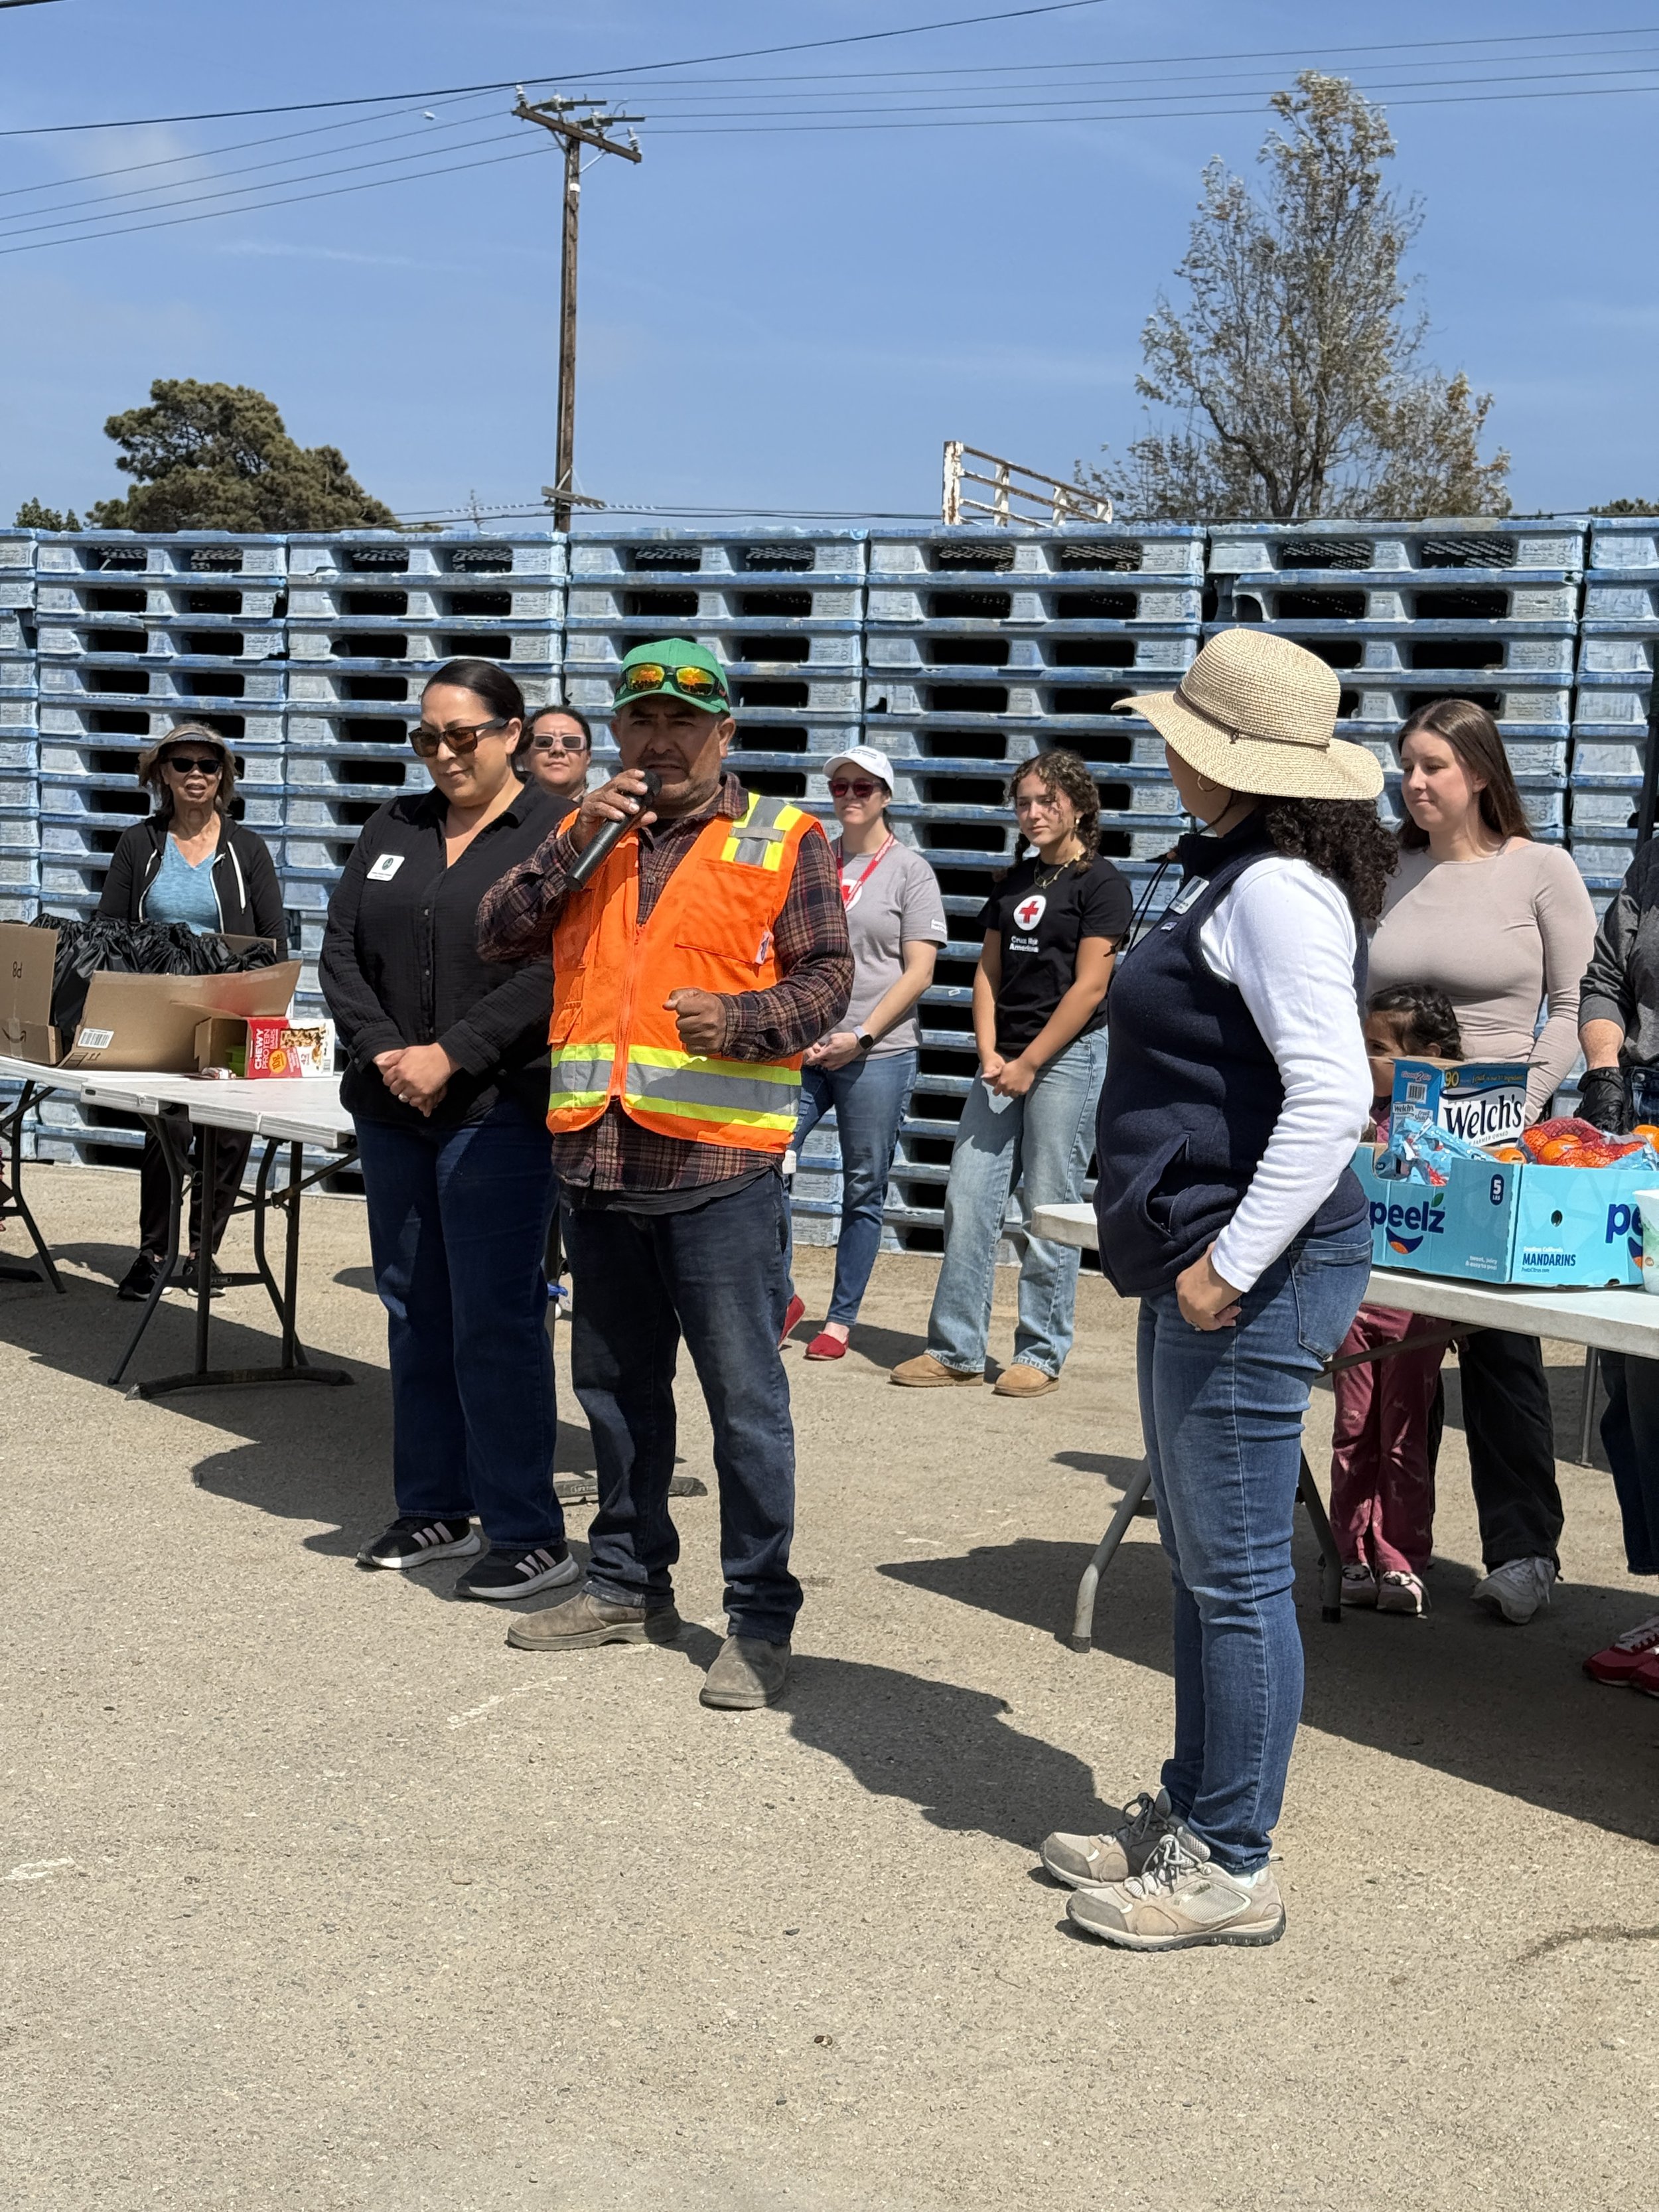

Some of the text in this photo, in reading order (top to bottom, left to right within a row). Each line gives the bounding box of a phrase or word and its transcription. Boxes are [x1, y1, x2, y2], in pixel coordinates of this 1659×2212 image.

[254, 1028, 264, 1070] CHEWY
[261, 1028, 270, 1069] PROTEIN
[1445, 1071, 1459, 1087] 90
[1394, 1103, 1415, 1112] Welch's
[1444, 1094, 1522, 1140] Welch's
[1473, 1134, 1492, 1147] FARMER
[1492, 1130, 1508, 1140] OWNED
[1492, 1179, 1502, 1195] 5
[1370, 1201, 1445, 1234] peelz
[1522, 1252, 1576, 1267] MANDARINS
